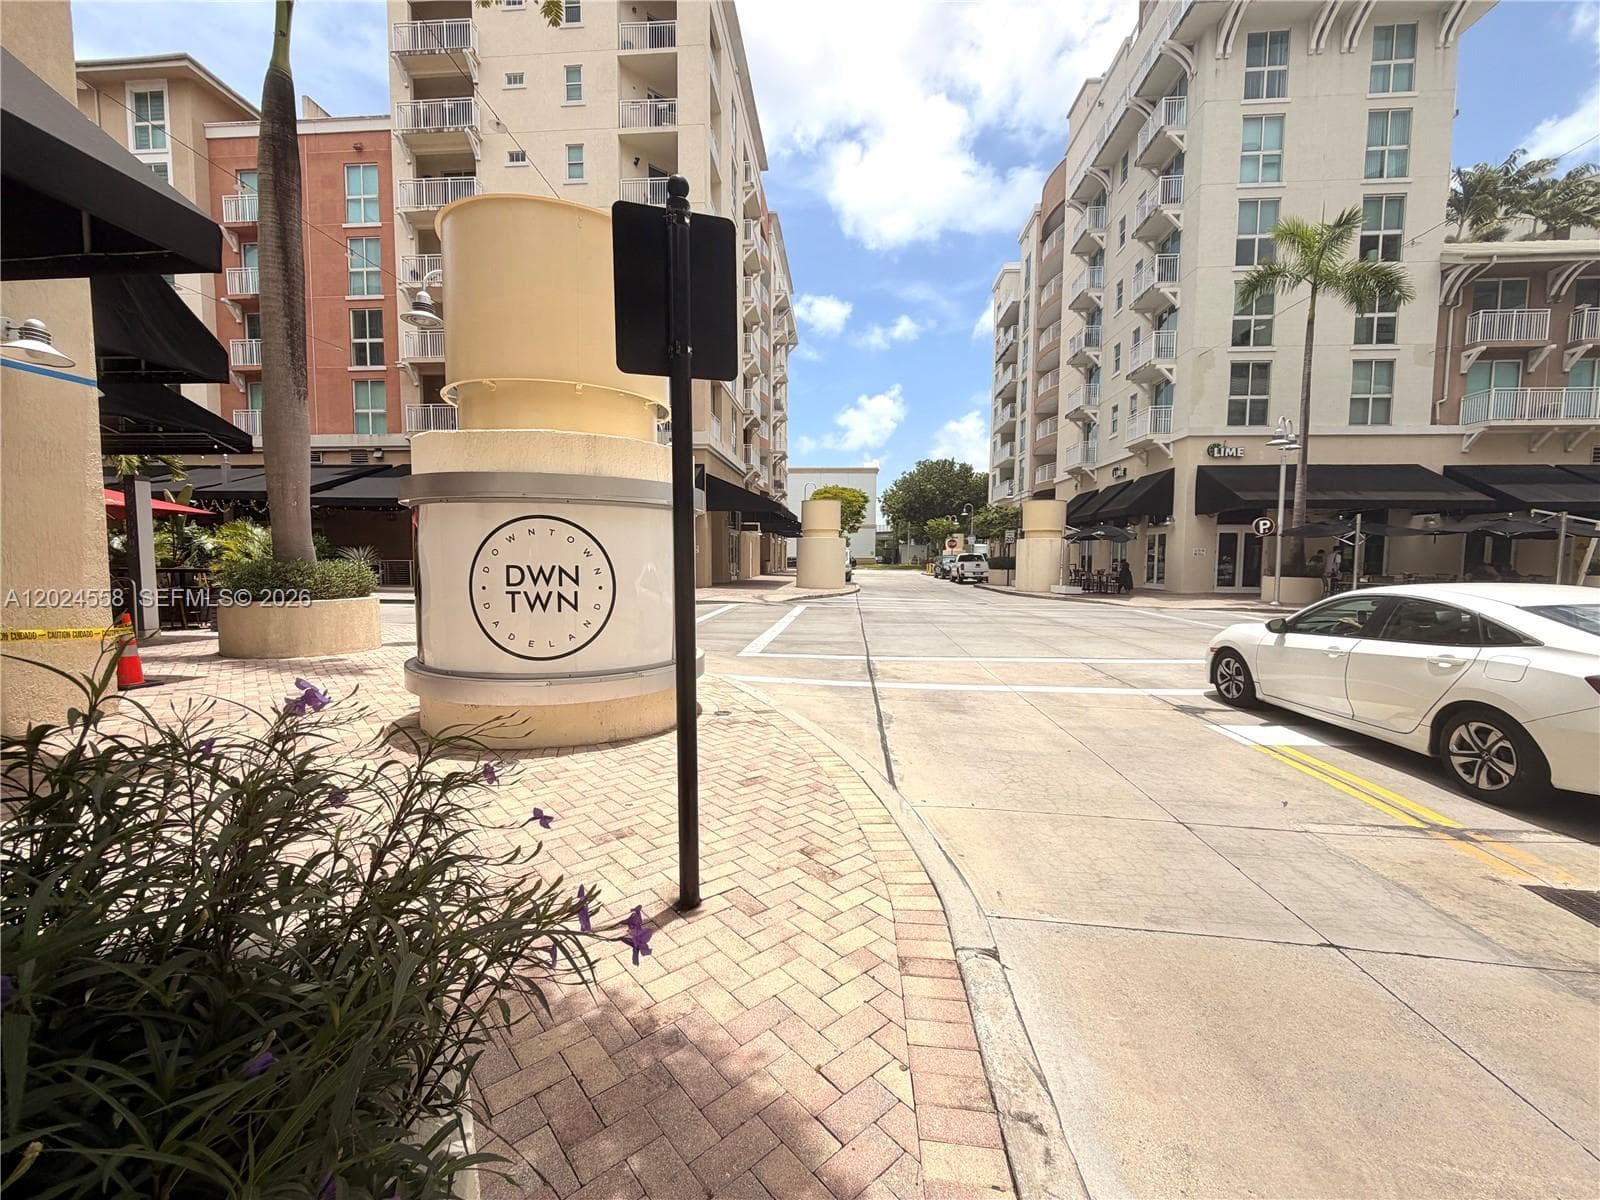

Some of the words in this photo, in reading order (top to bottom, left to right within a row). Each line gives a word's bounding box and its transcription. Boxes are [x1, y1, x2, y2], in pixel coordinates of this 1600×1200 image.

[1213, 447, 1245, 458] LIME
[1259, 520, 1271, 534] P
[483, 528, 602, 575] DOWNTOWN
[505, 564, 580, 588] DWN
[505, 590, 579, 613] TWN
[10, 631, 37, 641] CUIDADO
[47, 630, 71, 640] CAUTION
[72, 629, 94, 639] CUIDADO
[483, 602, 601, 648] DADELAND
